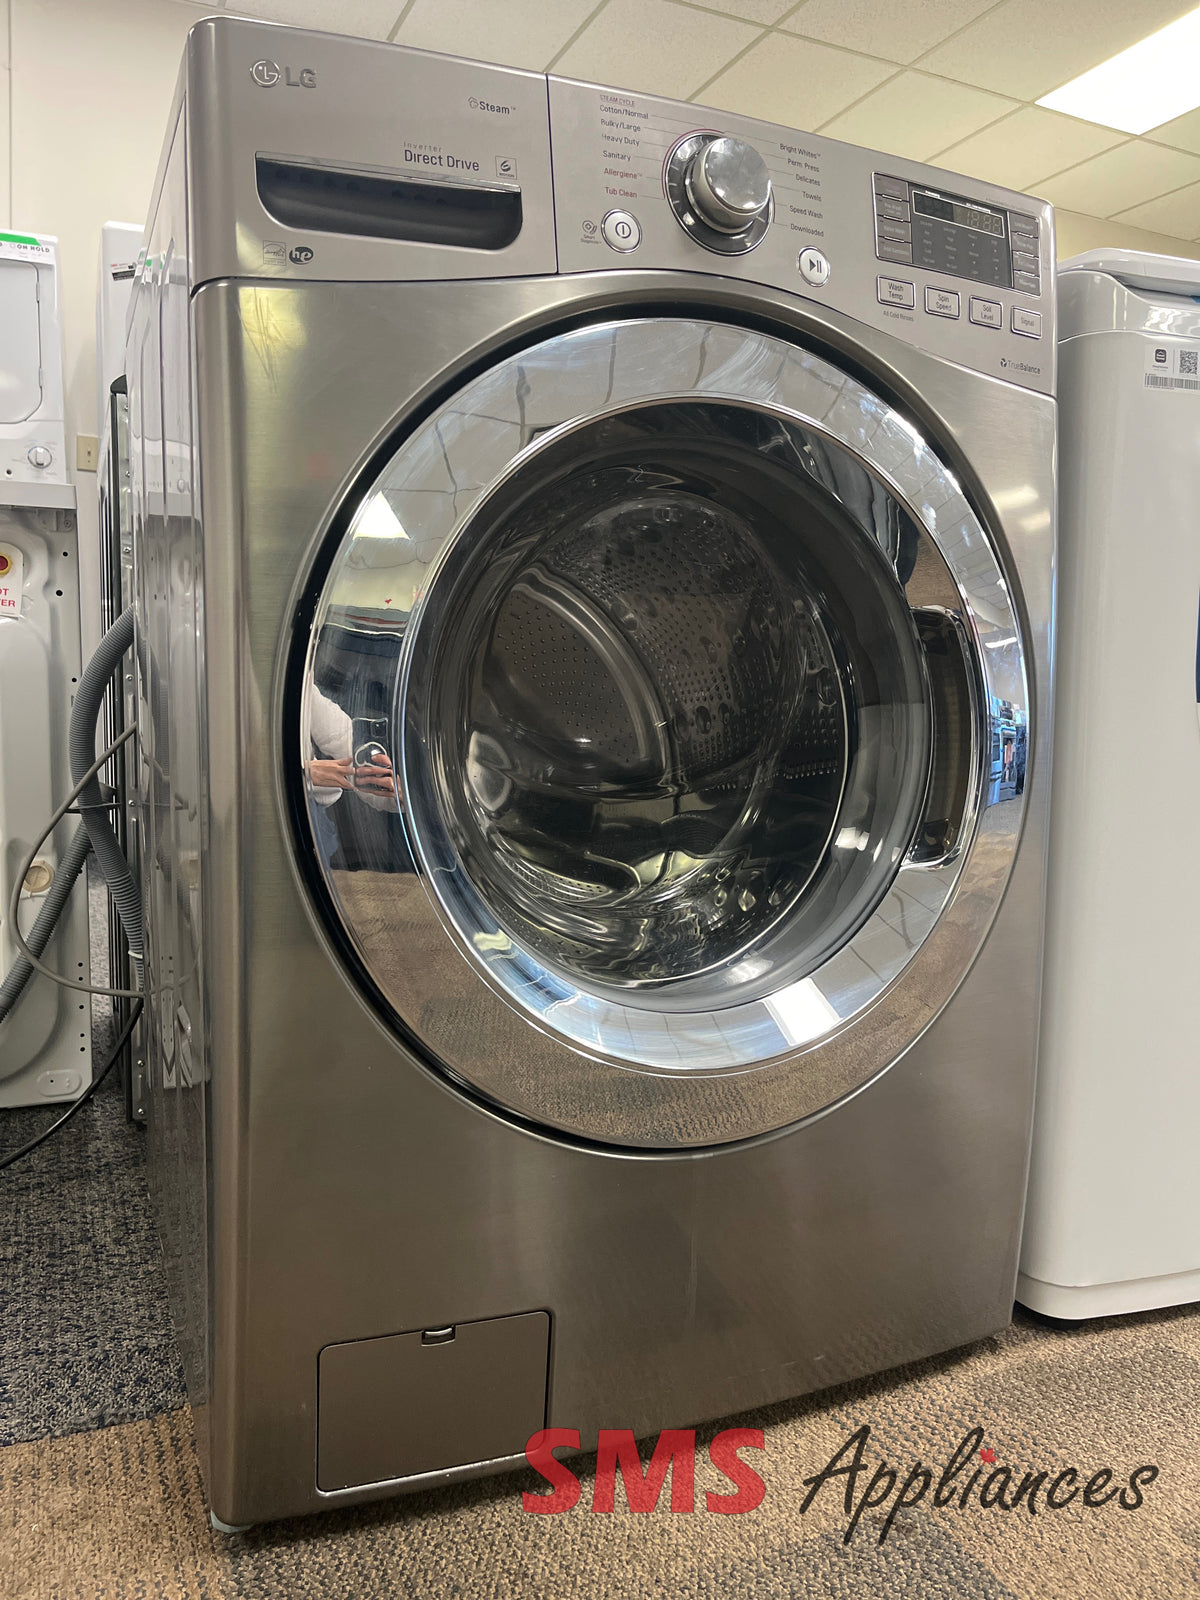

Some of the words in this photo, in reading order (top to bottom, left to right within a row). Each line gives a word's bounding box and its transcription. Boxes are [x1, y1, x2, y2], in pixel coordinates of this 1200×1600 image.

[285, 66, 317, 88] LG
[600, 105, 649, 119] Cotton/Normal
[600, 118, 641, 132] Bulky/Large
[601, 133, 623, 144] Heavy
[624, 136, 640, 147] Duty
[403, 141, 443, 153] Inverter
[779, 143, 797, 154] Bright
[404, 149, 444, 167] Direct
[446, 155, 480, 172] Drive
[602, 150, 631, 162] Sanitary
[804, 162, 820, 172] Press
[795, 173, 821, 187] Delicates
[604, 186, 618, 196] Tub
[619, 188, 638, 199] Clean
[801, 190, 822, 202] Towels
[789, 204, 807, 216] Speed
[807, 209, 824, 219] Wash
[790, 223, 825, 237] Downloaded
[887, 282, 904, 292] Wash
[888, 290, 904, 301] Temp
[982, 305, 992, 313] Soil
[980, 311, 994, 321] Level
